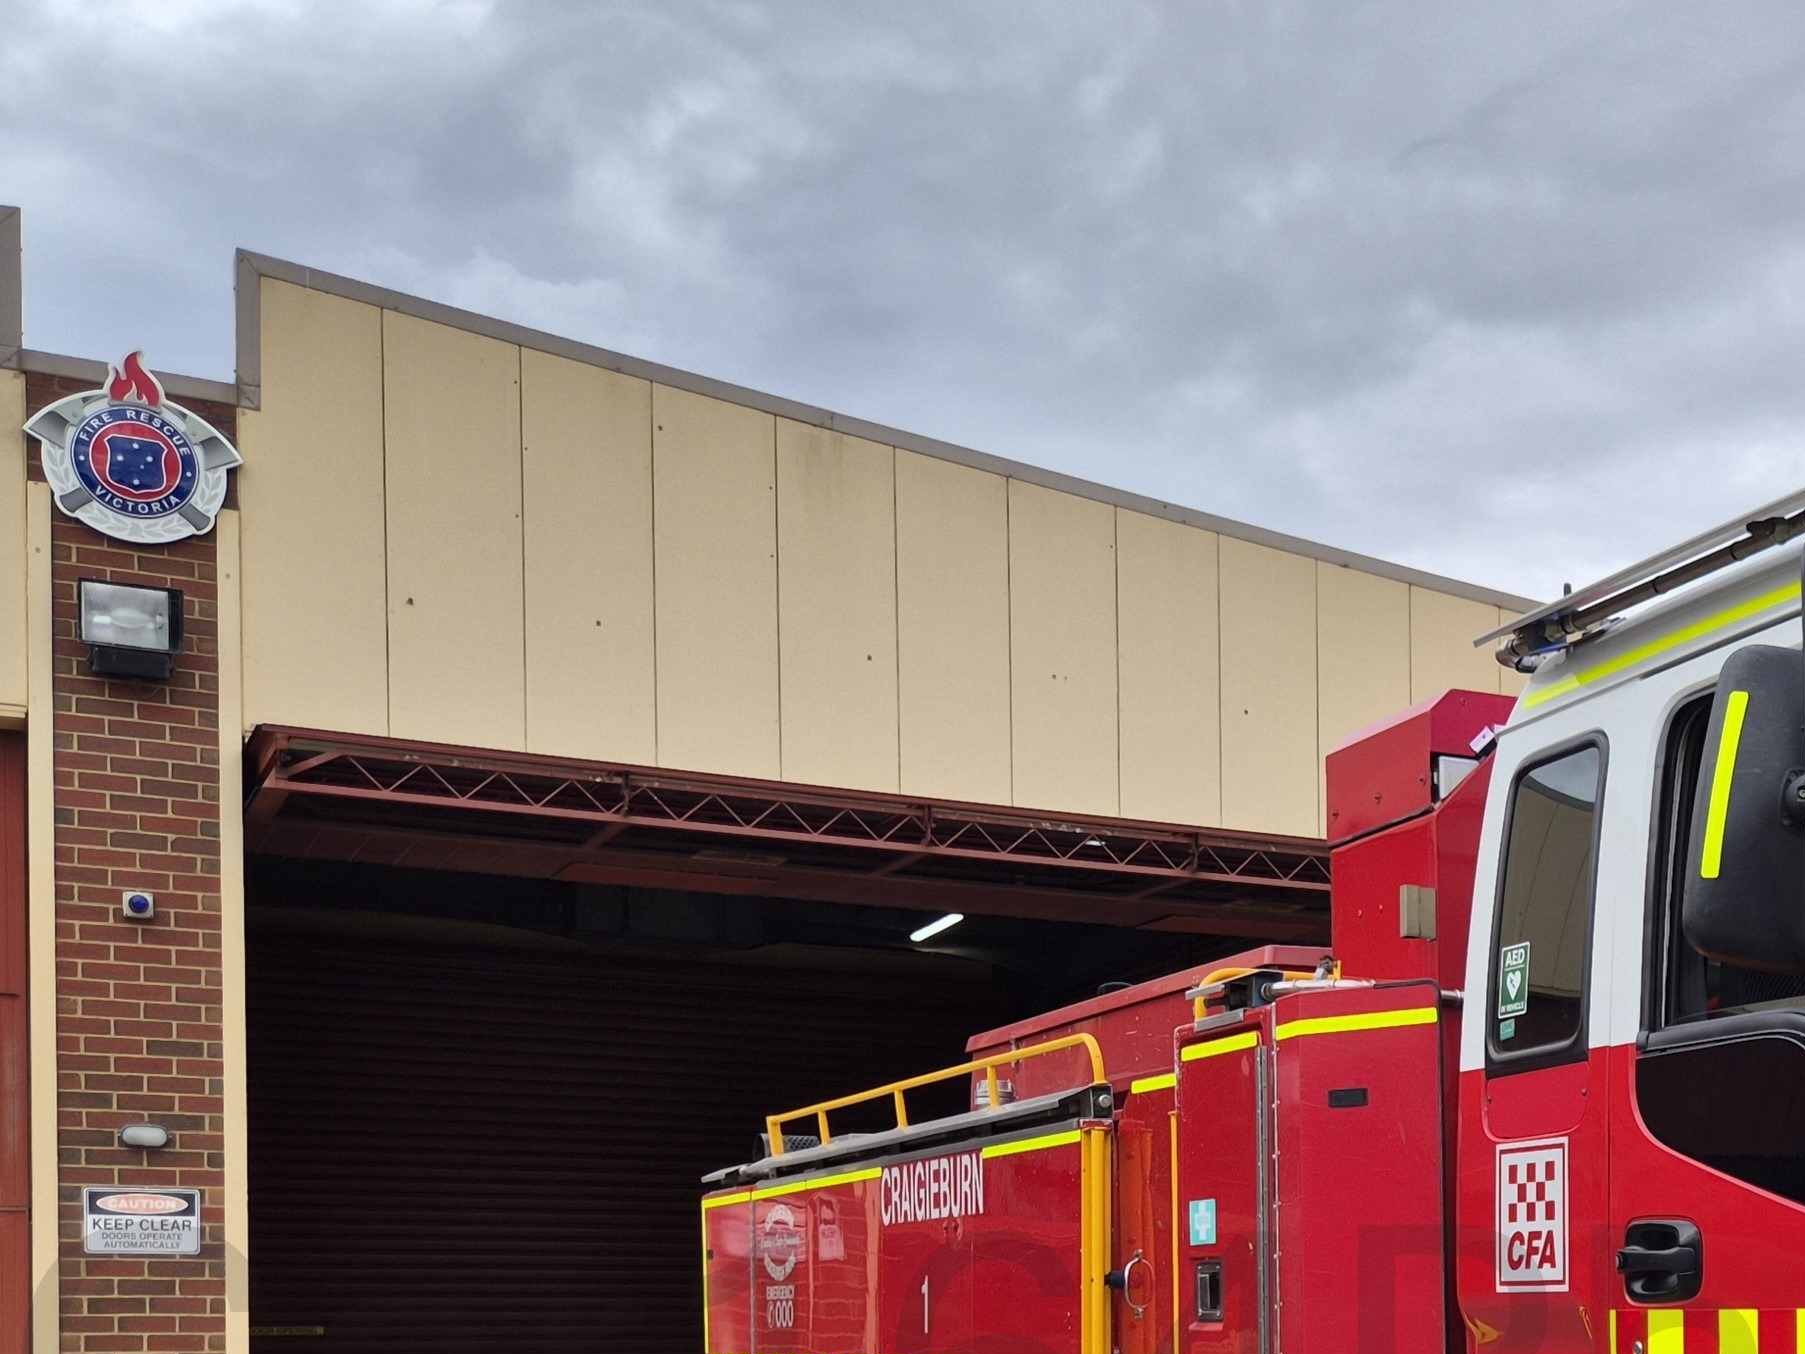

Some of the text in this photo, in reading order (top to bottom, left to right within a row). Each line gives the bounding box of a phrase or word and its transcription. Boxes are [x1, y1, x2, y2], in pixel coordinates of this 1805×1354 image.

[79, 409, 192, 457] FIRE RESCUE
[94, 485, 181, 515] VICTORIA
[1505, 948, 1526, 967] AED
[880, 1153, 985, 1227] CRAIGIEBURN
[107, 1199, 177, 1210] CAUTION
[92, 1218, 192, 1232] KEEP CLEAR
[101, 1232, 183, 1241] DOORS OPERATE
[104, 1240, 182, 1250] AUTOMATICALLY
[1507, 1230, 1557, 1271] CFA
[775, 1300, 794, 1328] 000
[920, 1275, 930, 1335] 1
